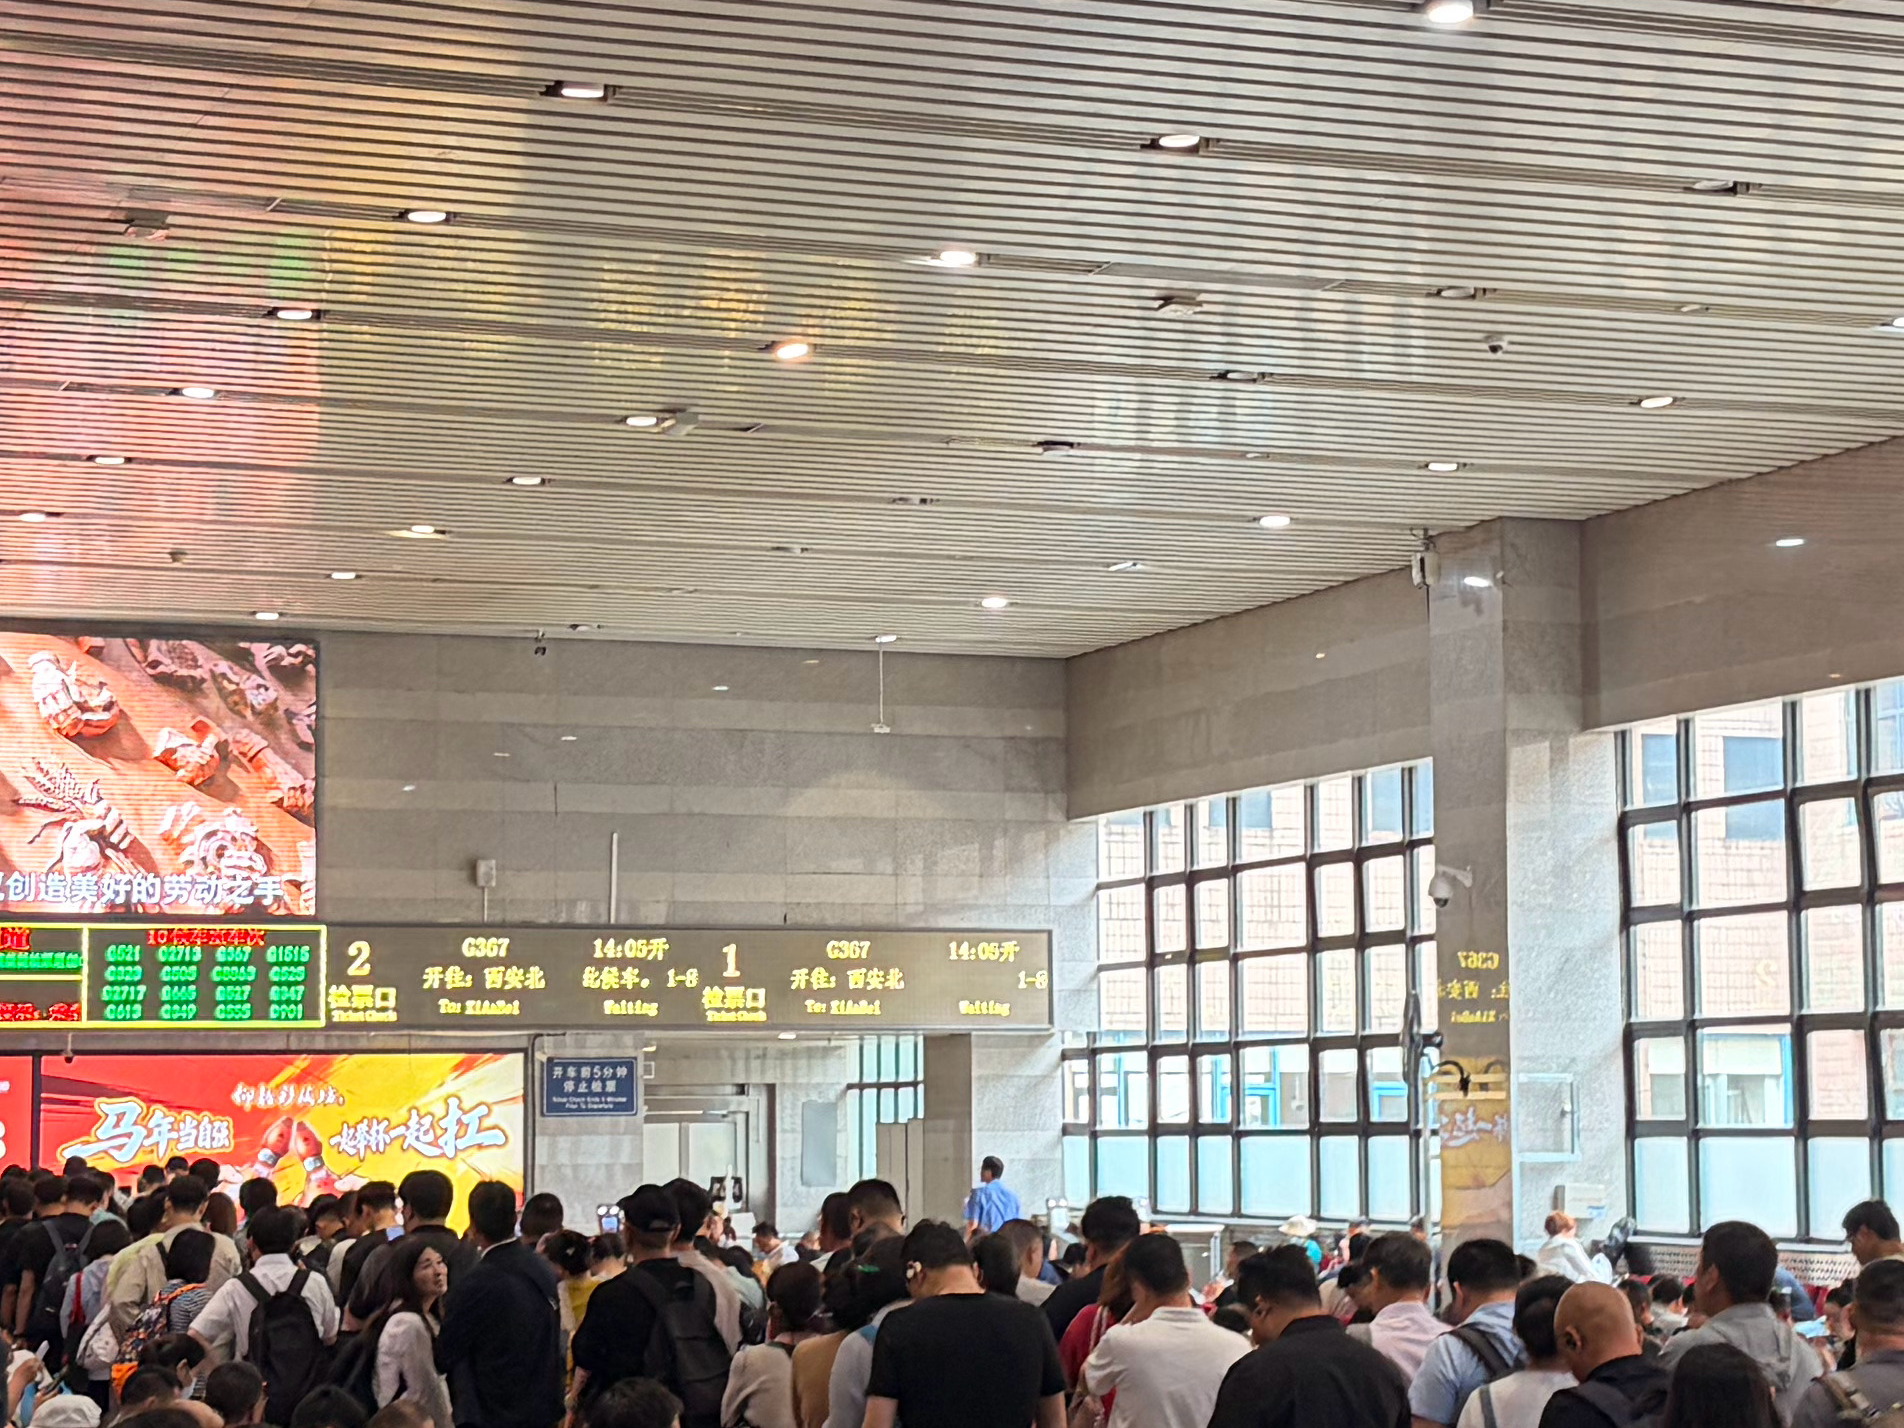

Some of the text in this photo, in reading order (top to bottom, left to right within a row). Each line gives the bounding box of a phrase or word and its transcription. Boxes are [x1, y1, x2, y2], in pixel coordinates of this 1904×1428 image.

[347, 940, 371, 976] 2
[462, 938, 510, 958] G367
[593, 938, 669, 961] 14:05开
[826, 940, 871, 960] G367
[948, 941, 1020, 962] 14:05开
[722, 943, 741, 978] 1
[484, 966, 545, 989] 西安北
[847, 967, 904, 990] 西安北
[327, 984, 397, 1009] 检票口
[702, 986, 766, 1009] 检票口
[552, 1065, 627, 1078] 开车前5分钟
[563, 1080, 616, 1092] 停止检票
